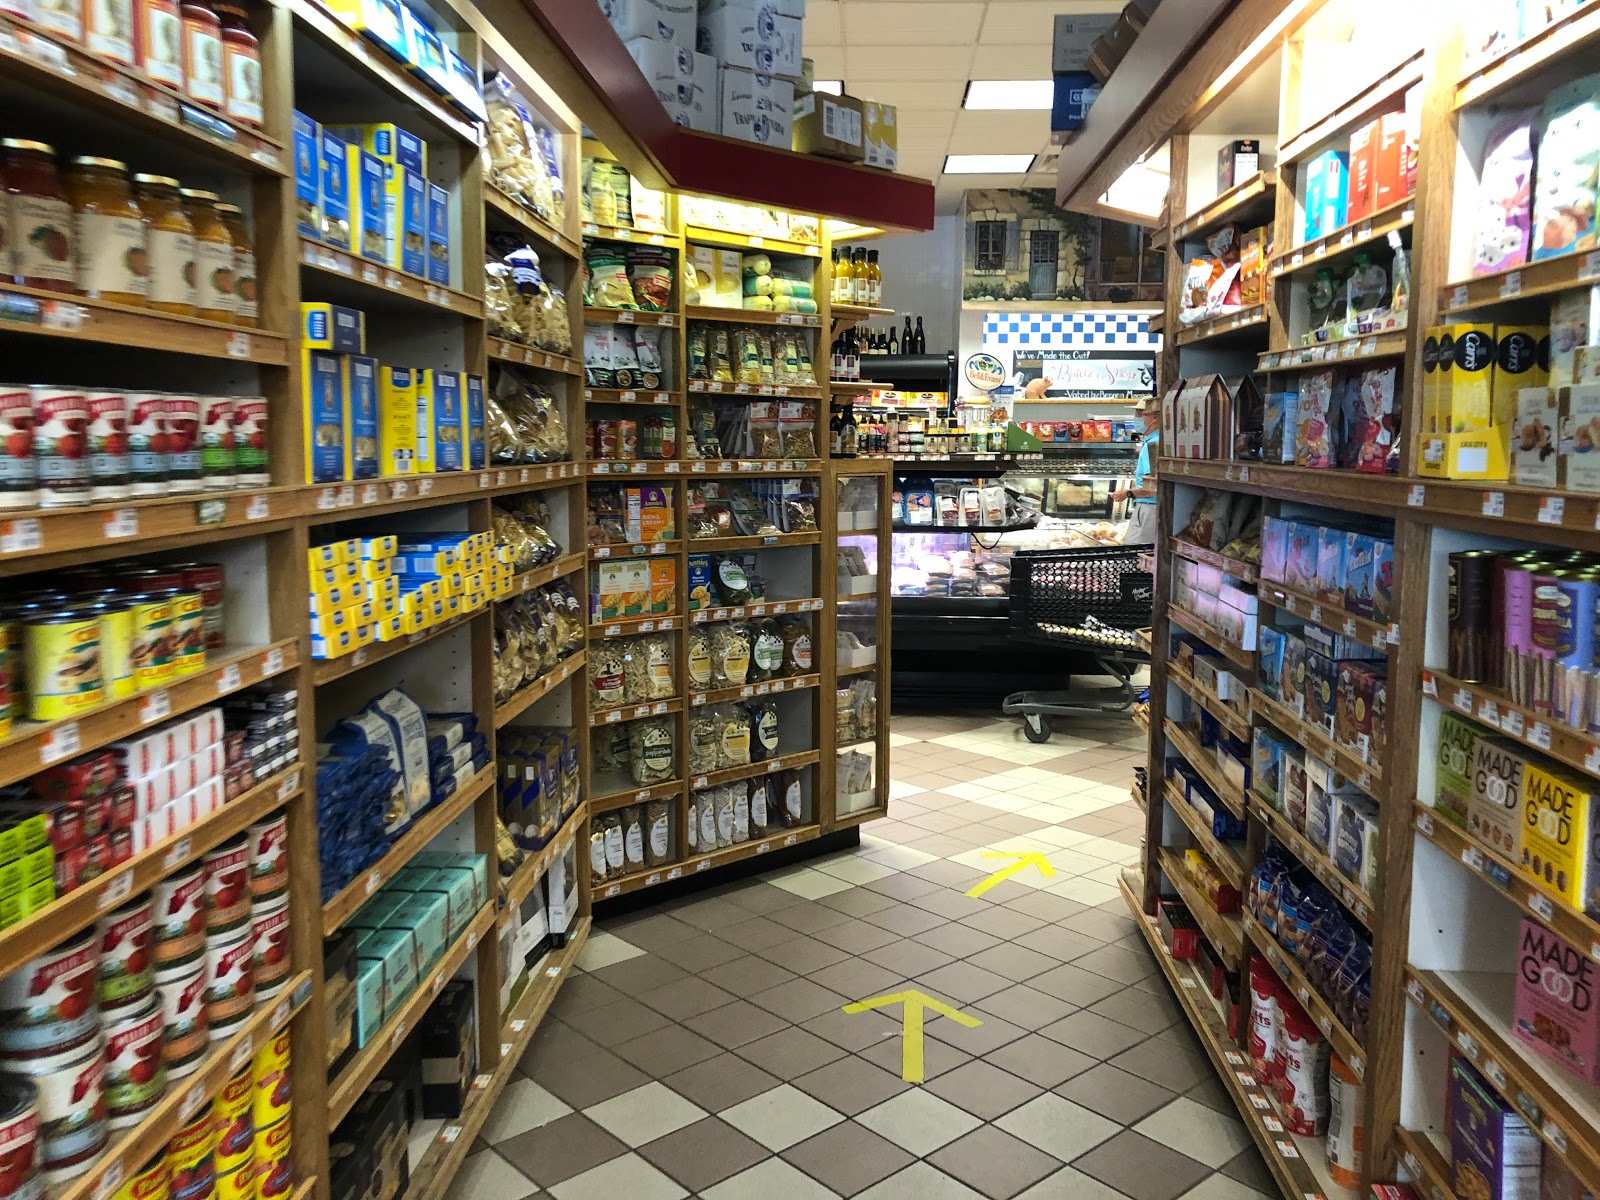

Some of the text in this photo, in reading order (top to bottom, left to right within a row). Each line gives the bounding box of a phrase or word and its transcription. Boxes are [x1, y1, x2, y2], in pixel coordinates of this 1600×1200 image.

[1037, 350, 1057, 359] Made
[1058, 350, 1071, 359] the
[1442, 720, 1477, 756] MADE
[1478, 746, 1521, 787] MADE
[1476, 769, 1518, 809] GOOD
[1527, 773, 1574, 820] MADE
[1526, 799, 1571, 846] GOOD
[1522, 926, 1594, 987] MADE
[1521, 955, 1591, 1012] GOOD
